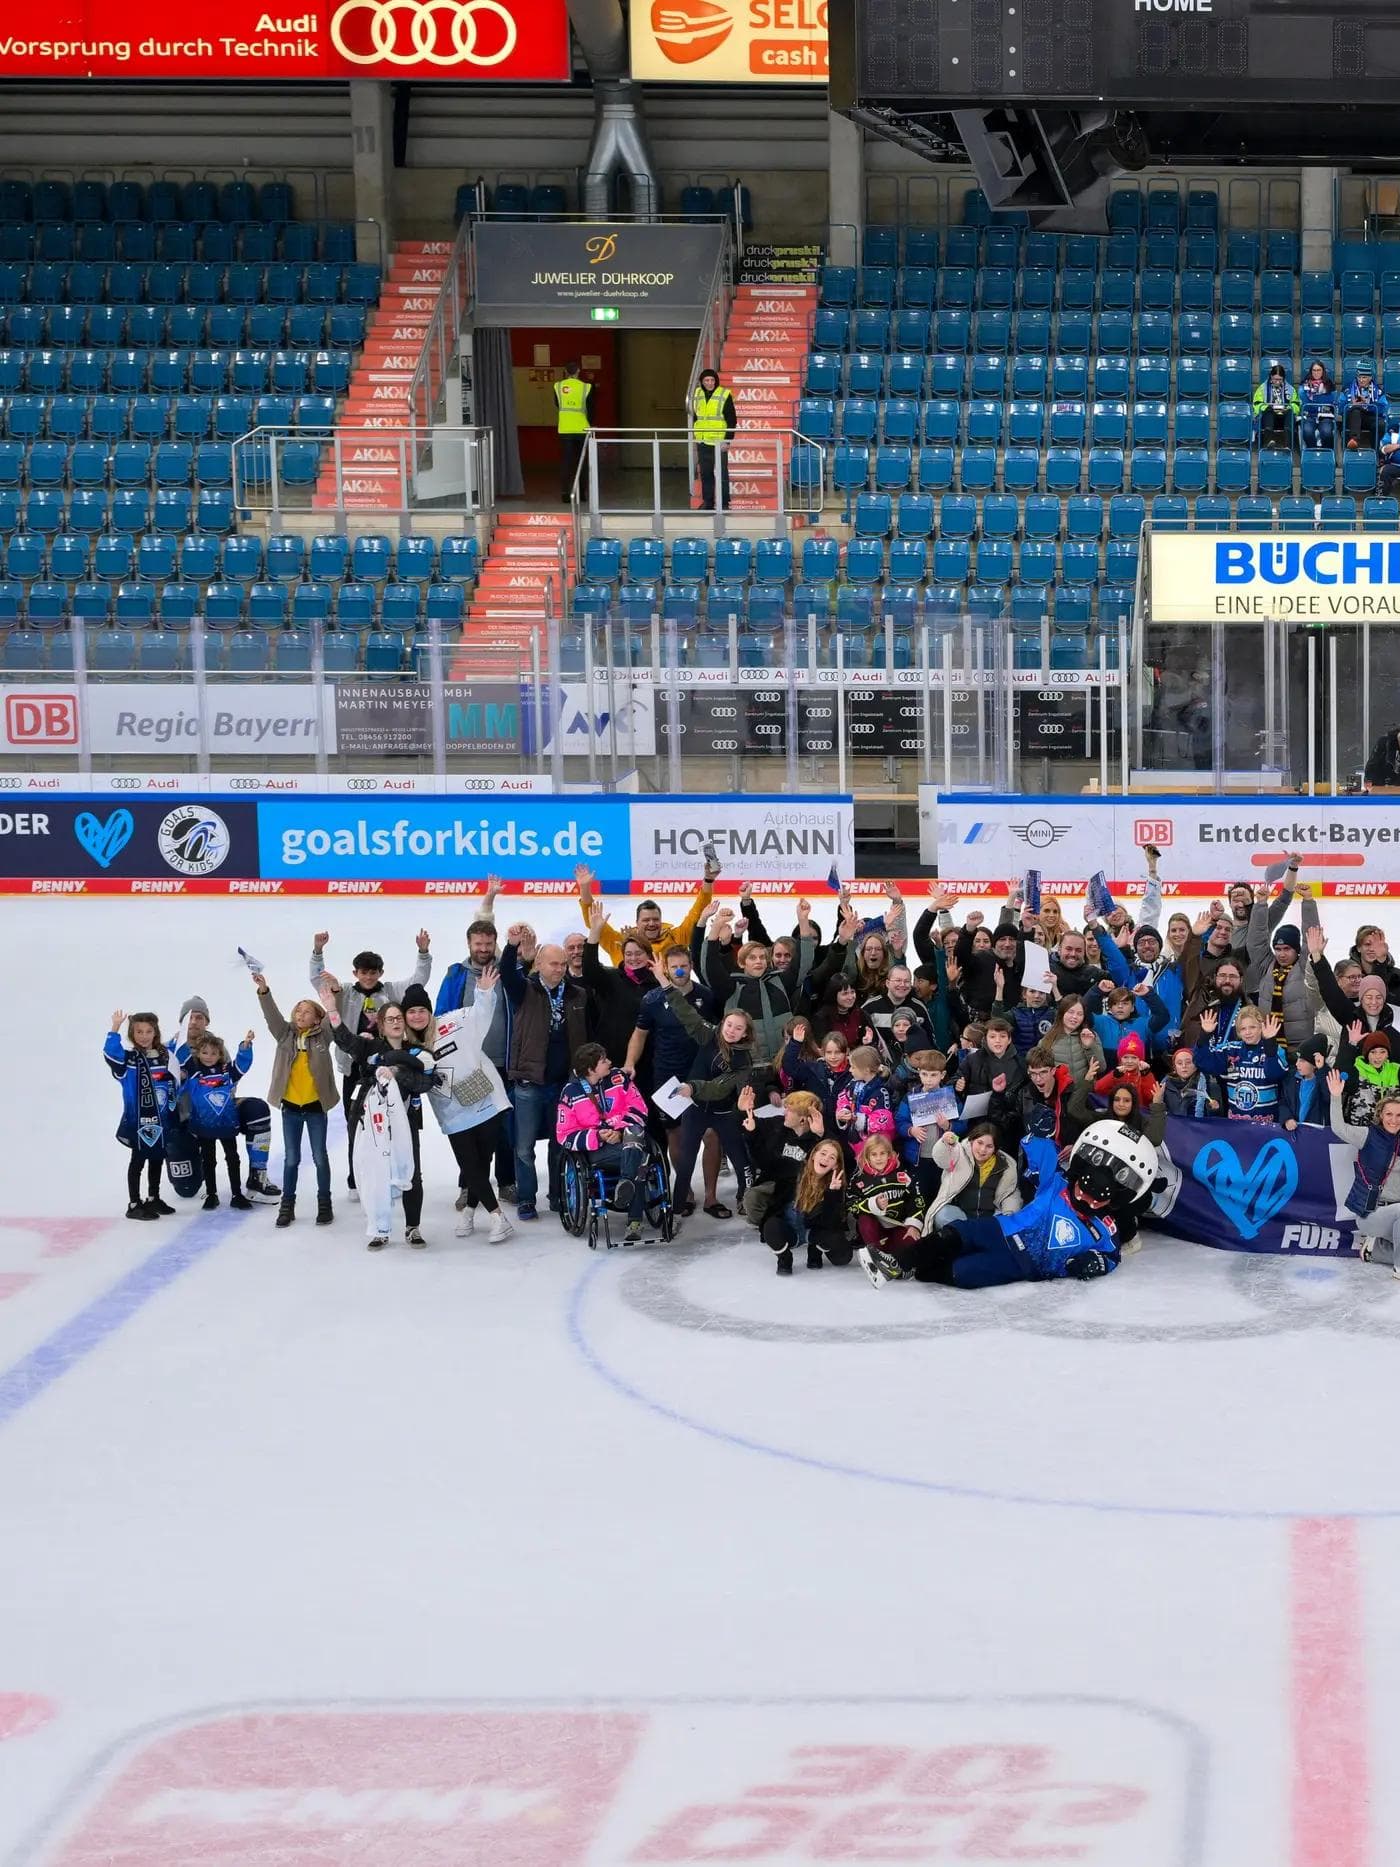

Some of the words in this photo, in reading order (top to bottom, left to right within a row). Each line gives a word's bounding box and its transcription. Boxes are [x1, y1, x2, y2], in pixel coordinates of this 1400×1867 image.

[1135, 0, 1212, 12] HOME
[256, 14, 318, 33] Audi
[0, 37, 131, 61] Vorsprung
[142, 37, 213, 57] durch
[219, 38, 319, 57] Technik
[761, 45, 817, 66] cash
[531, 272, 597, 286] JUWELIER
[602, 269, 674, 286] DÜHRKOOP
[557, 289, 649, 299] www.juwelier-duehrkoop.de
[1215, 596, 1266, 614] EINE
[1273, 596, 1321, 614] IDEE
[698, 672, 728, 680] Audi
[338, 688, 430, 698] INNENAUSBAU
[338, 701, 391, 710] MARTIN
[15, 702, 72, 737] DB
[449, 703, 517, 739] MM
[28, 778, 60, 788] Audi
[147, 778, 179, 788] Audi
[265, 779, 298, 789] Audi
[383, 779, 416, 789] Audi
[501, 780, 533, 790] Audi
[160, 806, 195, 837] GOALS
[763, 811, 834, 825] Autohaus
[1029, 829, 1051, 838] MINI
[1139, 824, 1168, 842] DB
[281, 819, 603, 866] goalsforkids.de
[653, 829, 834, 855] HOFMANN
[164, 848, 184, 870] FOR
[187, 858, 214, 873] KIDS
[655, 860, 669, 869] Ein
[737, 860, 753, 869] der
[1280, 1222, 1341, 1250] FÜR
